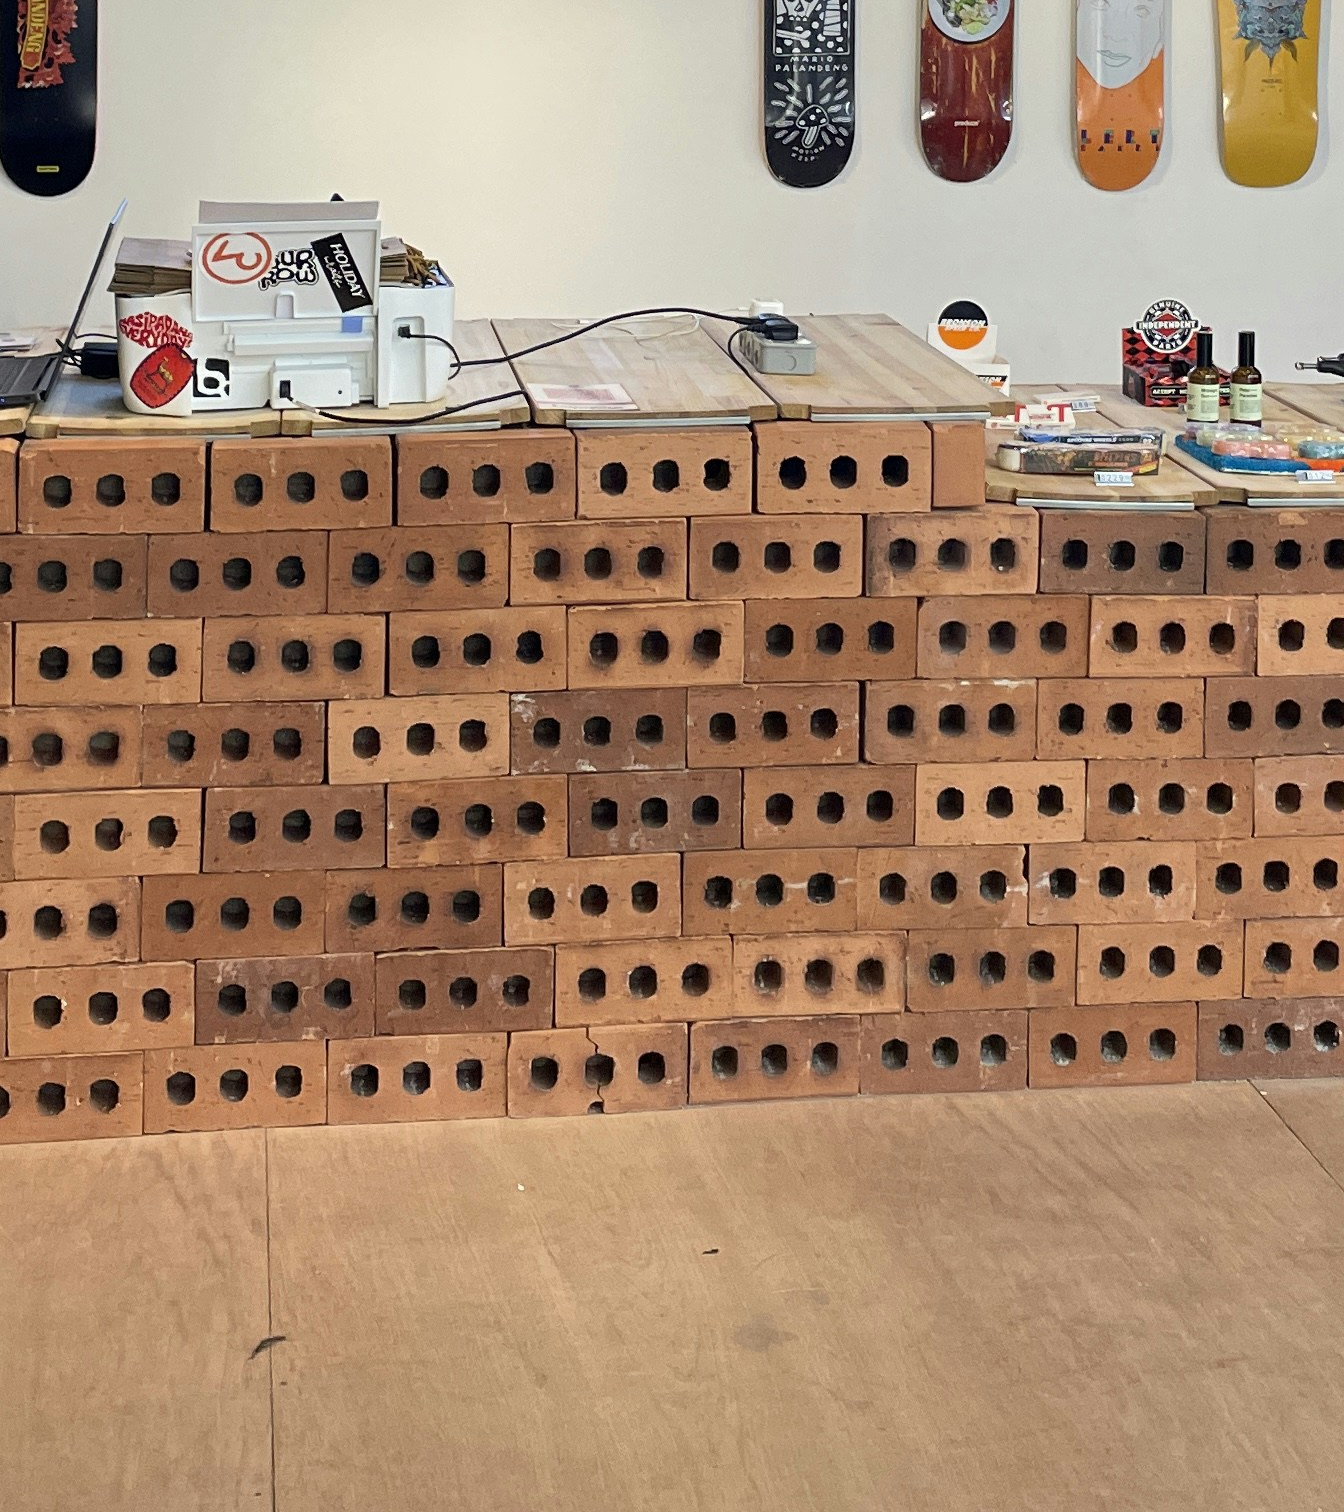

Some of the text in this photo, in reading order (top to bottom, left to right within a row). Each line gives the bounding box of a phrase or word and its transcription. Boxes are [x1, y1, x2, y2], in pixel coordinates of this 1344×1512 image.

[790, 55, 833, 63] MARIO
[775, 63, 848, 72] PALANDENG
[329, 243, 366, 300] HOLIDAY
[1139, 321, 1196, 329] INDEPENDENT
